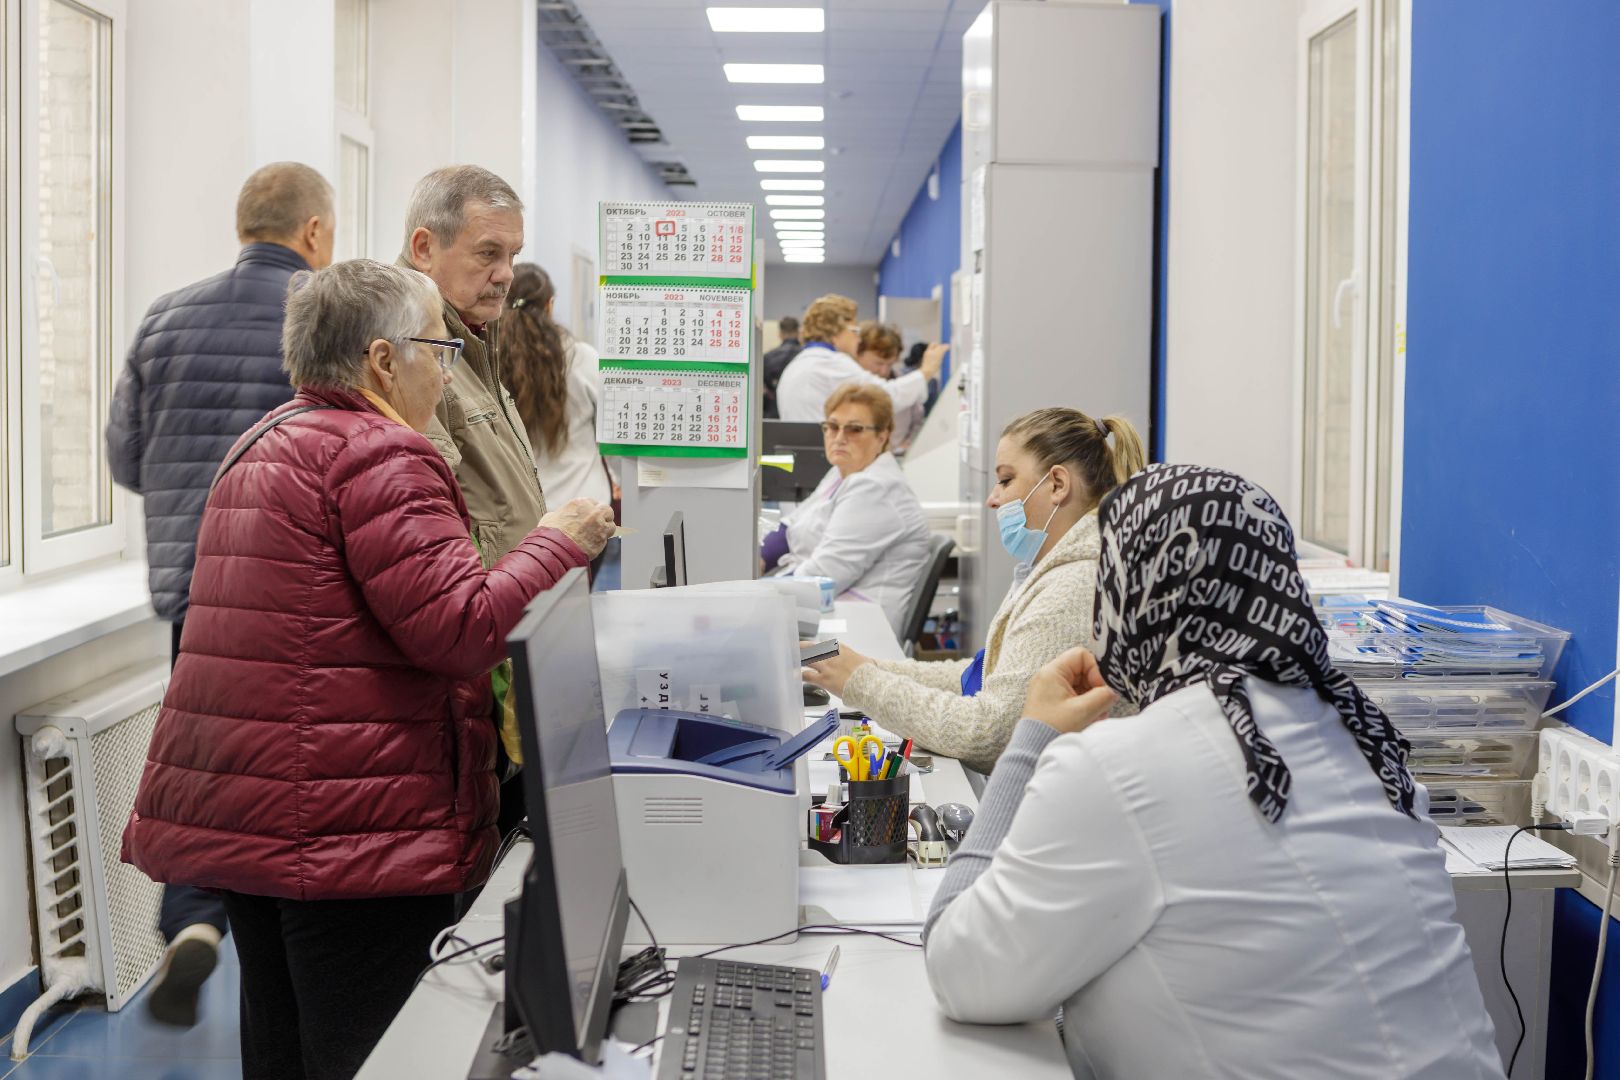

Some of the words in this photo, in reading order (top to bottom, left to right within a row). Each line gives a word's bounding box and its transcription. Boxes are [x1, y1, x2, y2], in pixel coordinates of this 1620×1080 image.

[606, 208, 647, 216] ОКТЯБРЬ
[665, 209, 686, 217] 2023
[707, 210, 746, 218] OCTOBER
[627, 223, 633, 231] 2
[681, 224, 687, 232] 5
[718, 225, 724, 233] 7
[627, 233, 633, 241] 9
[639, 233, 650, 241] 10
[676, 234, 687, 242] 12
[694, 234, 705, 242] 13
[712, 235, 724, 243] 14
[730, 235, 742, 244] 15
[657, 243, 668, 251] 18
[711, 244, 722, 252] 21
[729, 245, 742, 253] 22
[621, 252, 632, 260] 23
[674, 253, 686, 261] 26
[711, 254, 723, 262] 28
[729, 255, 742, 263] 29
[621, 262, 632, 270] 30
[638, 262, 648, 270] 31
[664, 293, 684, 301] 2023
[699, 294, 744, 303] NOVEMBER
[662, 308, 666, 316] 1
[698, 309, 704, 317] 3
[625, 317, 631, 325] 6
[661, 318, 667, 326] 8
[680, 318, 685, 326] 9
[729, 320, 740, 328] 12
[620, 327, 631, 335] 13
[637, 327, 648, 335] 14
[673, 328, 685, 336] 16
[710, 329, 722, 337] 18
[729, 330, 740, 338] 19
[637, 337, 647, 345] 21
[655, 337, 667, 345] 22
[673, 338, 685, 346] 23
[691, 338, 703, 346] 24
[710, 339, 722, 347] 25
[619, 346, 630, 354] 27
[654, 347, 666, 355] 29
[673, 347, 685, 355] 30
[603, 377, 644, 385] ДЕКАБРЬ
[661, 378, 682, 387] 2023
[697, 379, 741, 388] DECEMBER
[714, 396, 720, 404] 2
[733, 396, 738, 404] 3
[624, 402, 629, 410] 4
[642, 403, 647, 411] 5
[678, 404, 683, 412] 7
[714, 405, 720, 413] 9
[726, 405, 738, 413] 10
[654, 413, 665, 421] 13
[690, 414, 702, 422] 15
[708, 415, 720, 423] 16
[726, 415, 738, 423] 17
[635, 422, 647, 430] 19
[653, 423, 665, 431] 20
[671, 423, 682, 431] 21
[689, 424, 701, 432] 22
[707, 424, 719, 432] 23
[726, 425, 737, 433] 24
[617, 431, 628, 439] 25
[653, 432, 664, 440] 27
[671, 433, 683, 441] 28
[707, 434, 719, 442] 30
[726, 434, 736, 442] 31
[659, 672, 669, 710] УЗД
